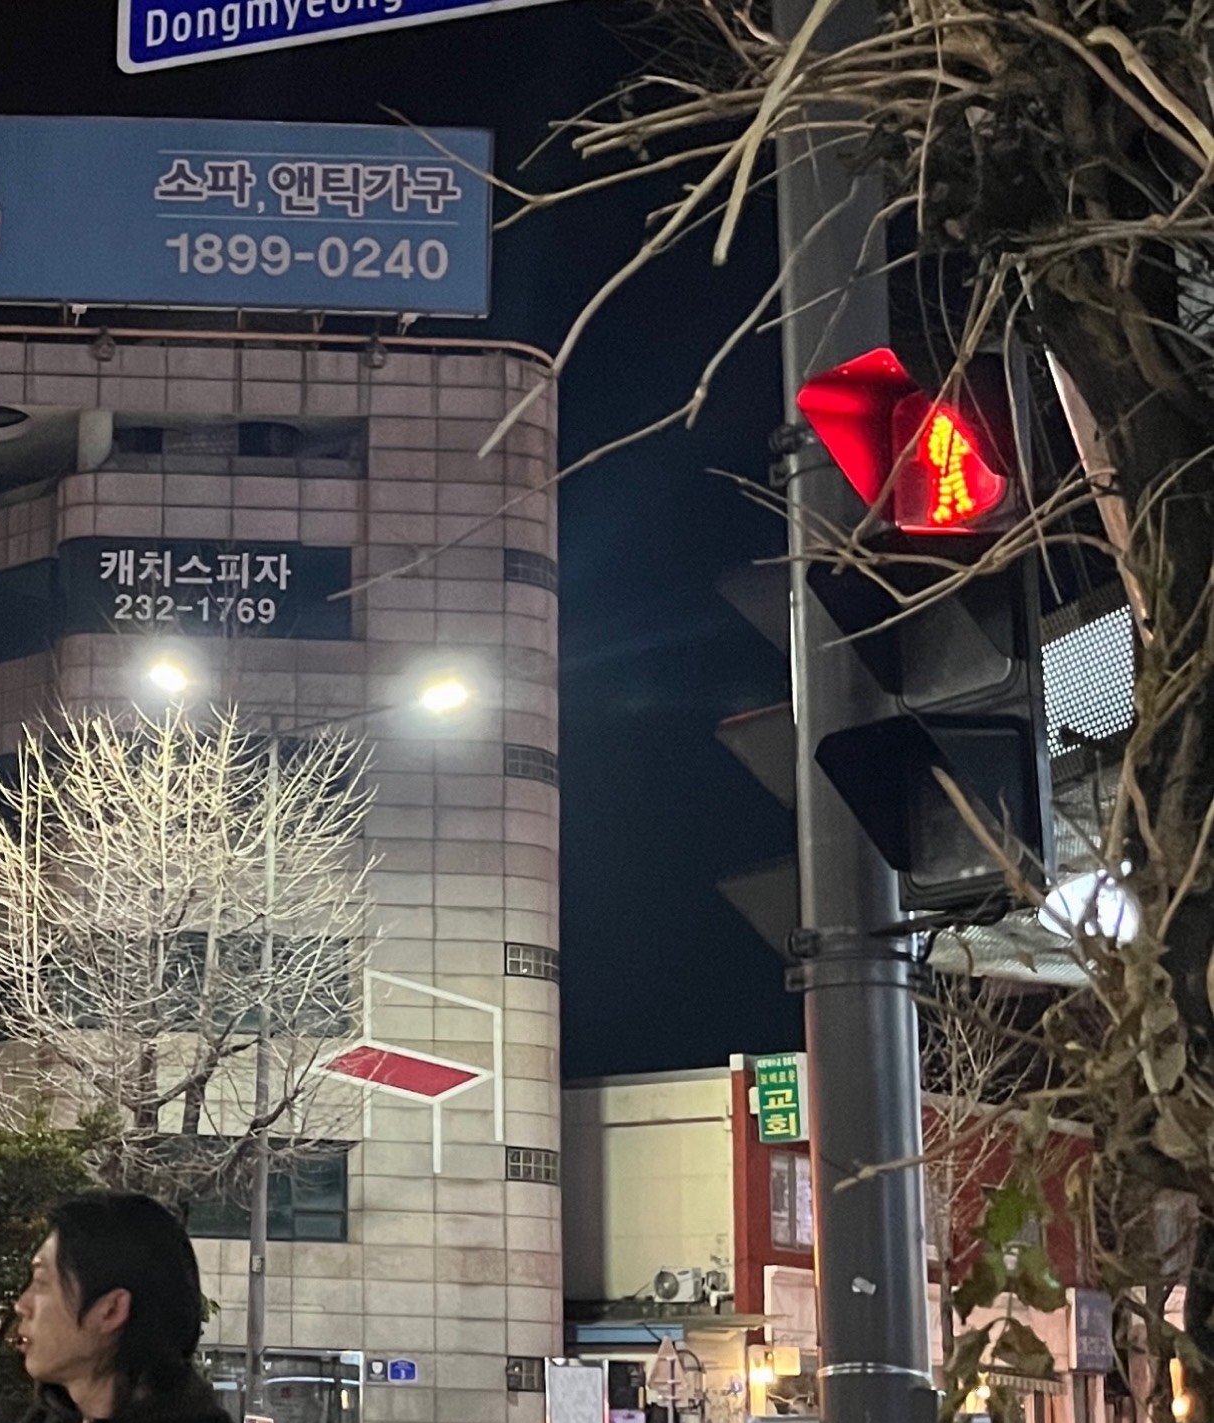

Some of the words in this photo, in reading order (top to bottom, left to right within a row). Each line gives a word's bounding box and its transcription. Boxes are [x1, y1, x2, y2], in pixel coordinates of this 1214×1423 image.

[146, 0, 402, 48] Dongmye
[268, 162, 462, 218] 앤틱가구
[165, 233, 450, 280] 1899-0240
[100, 550, 292, 590] 캐치스피자
[114, 594, 276, 624] 232-1769
[762, 1089, 797, 1137] 교회
